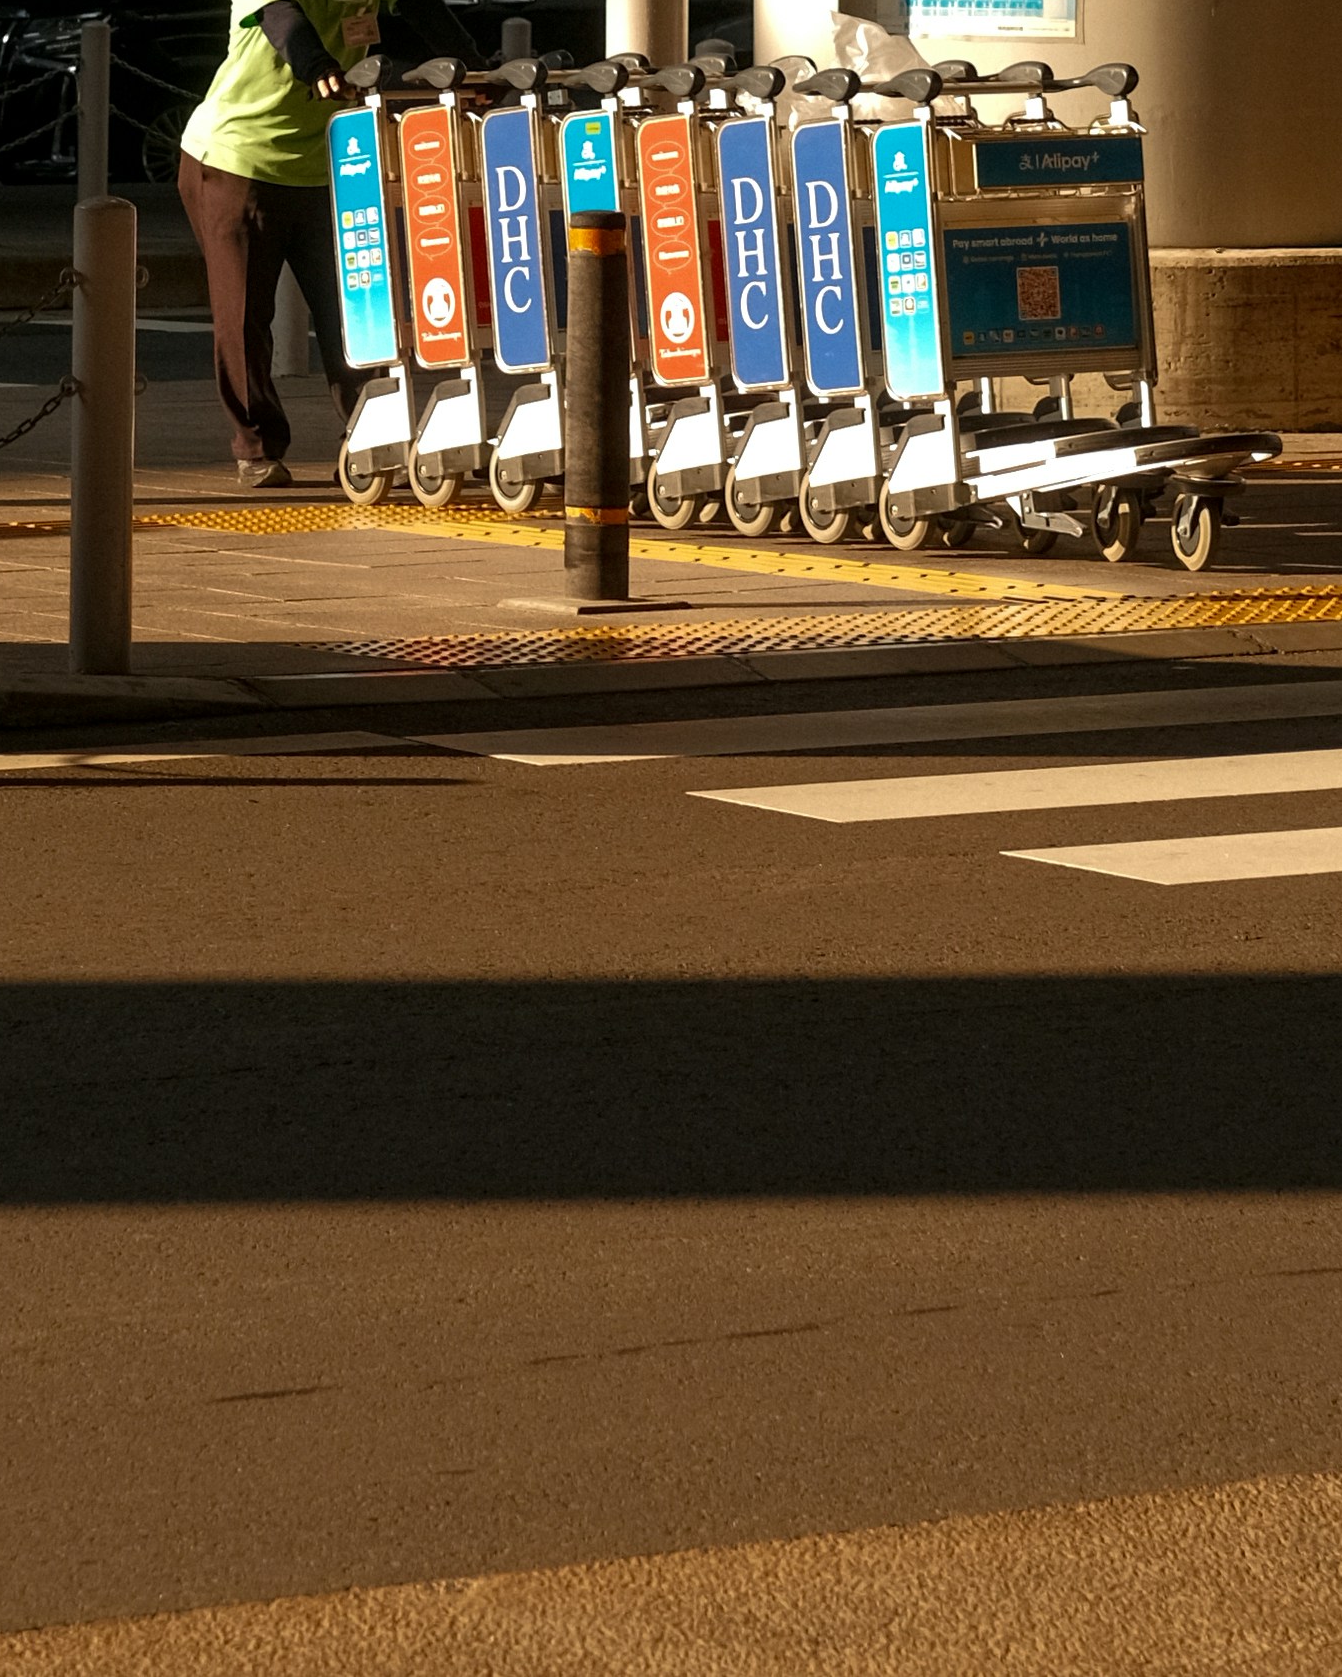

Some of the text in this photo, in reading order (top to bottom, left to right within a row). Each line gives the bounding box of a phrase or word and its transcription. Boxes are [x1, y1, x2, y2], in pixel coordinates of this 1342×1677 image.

[495, 165, 533, 314] DHC
[731, 177, 769, 330] DHC
[805, 180, 844, 335] DHC
[953, 232, 1118, 251] Pay smart abroad World as home
